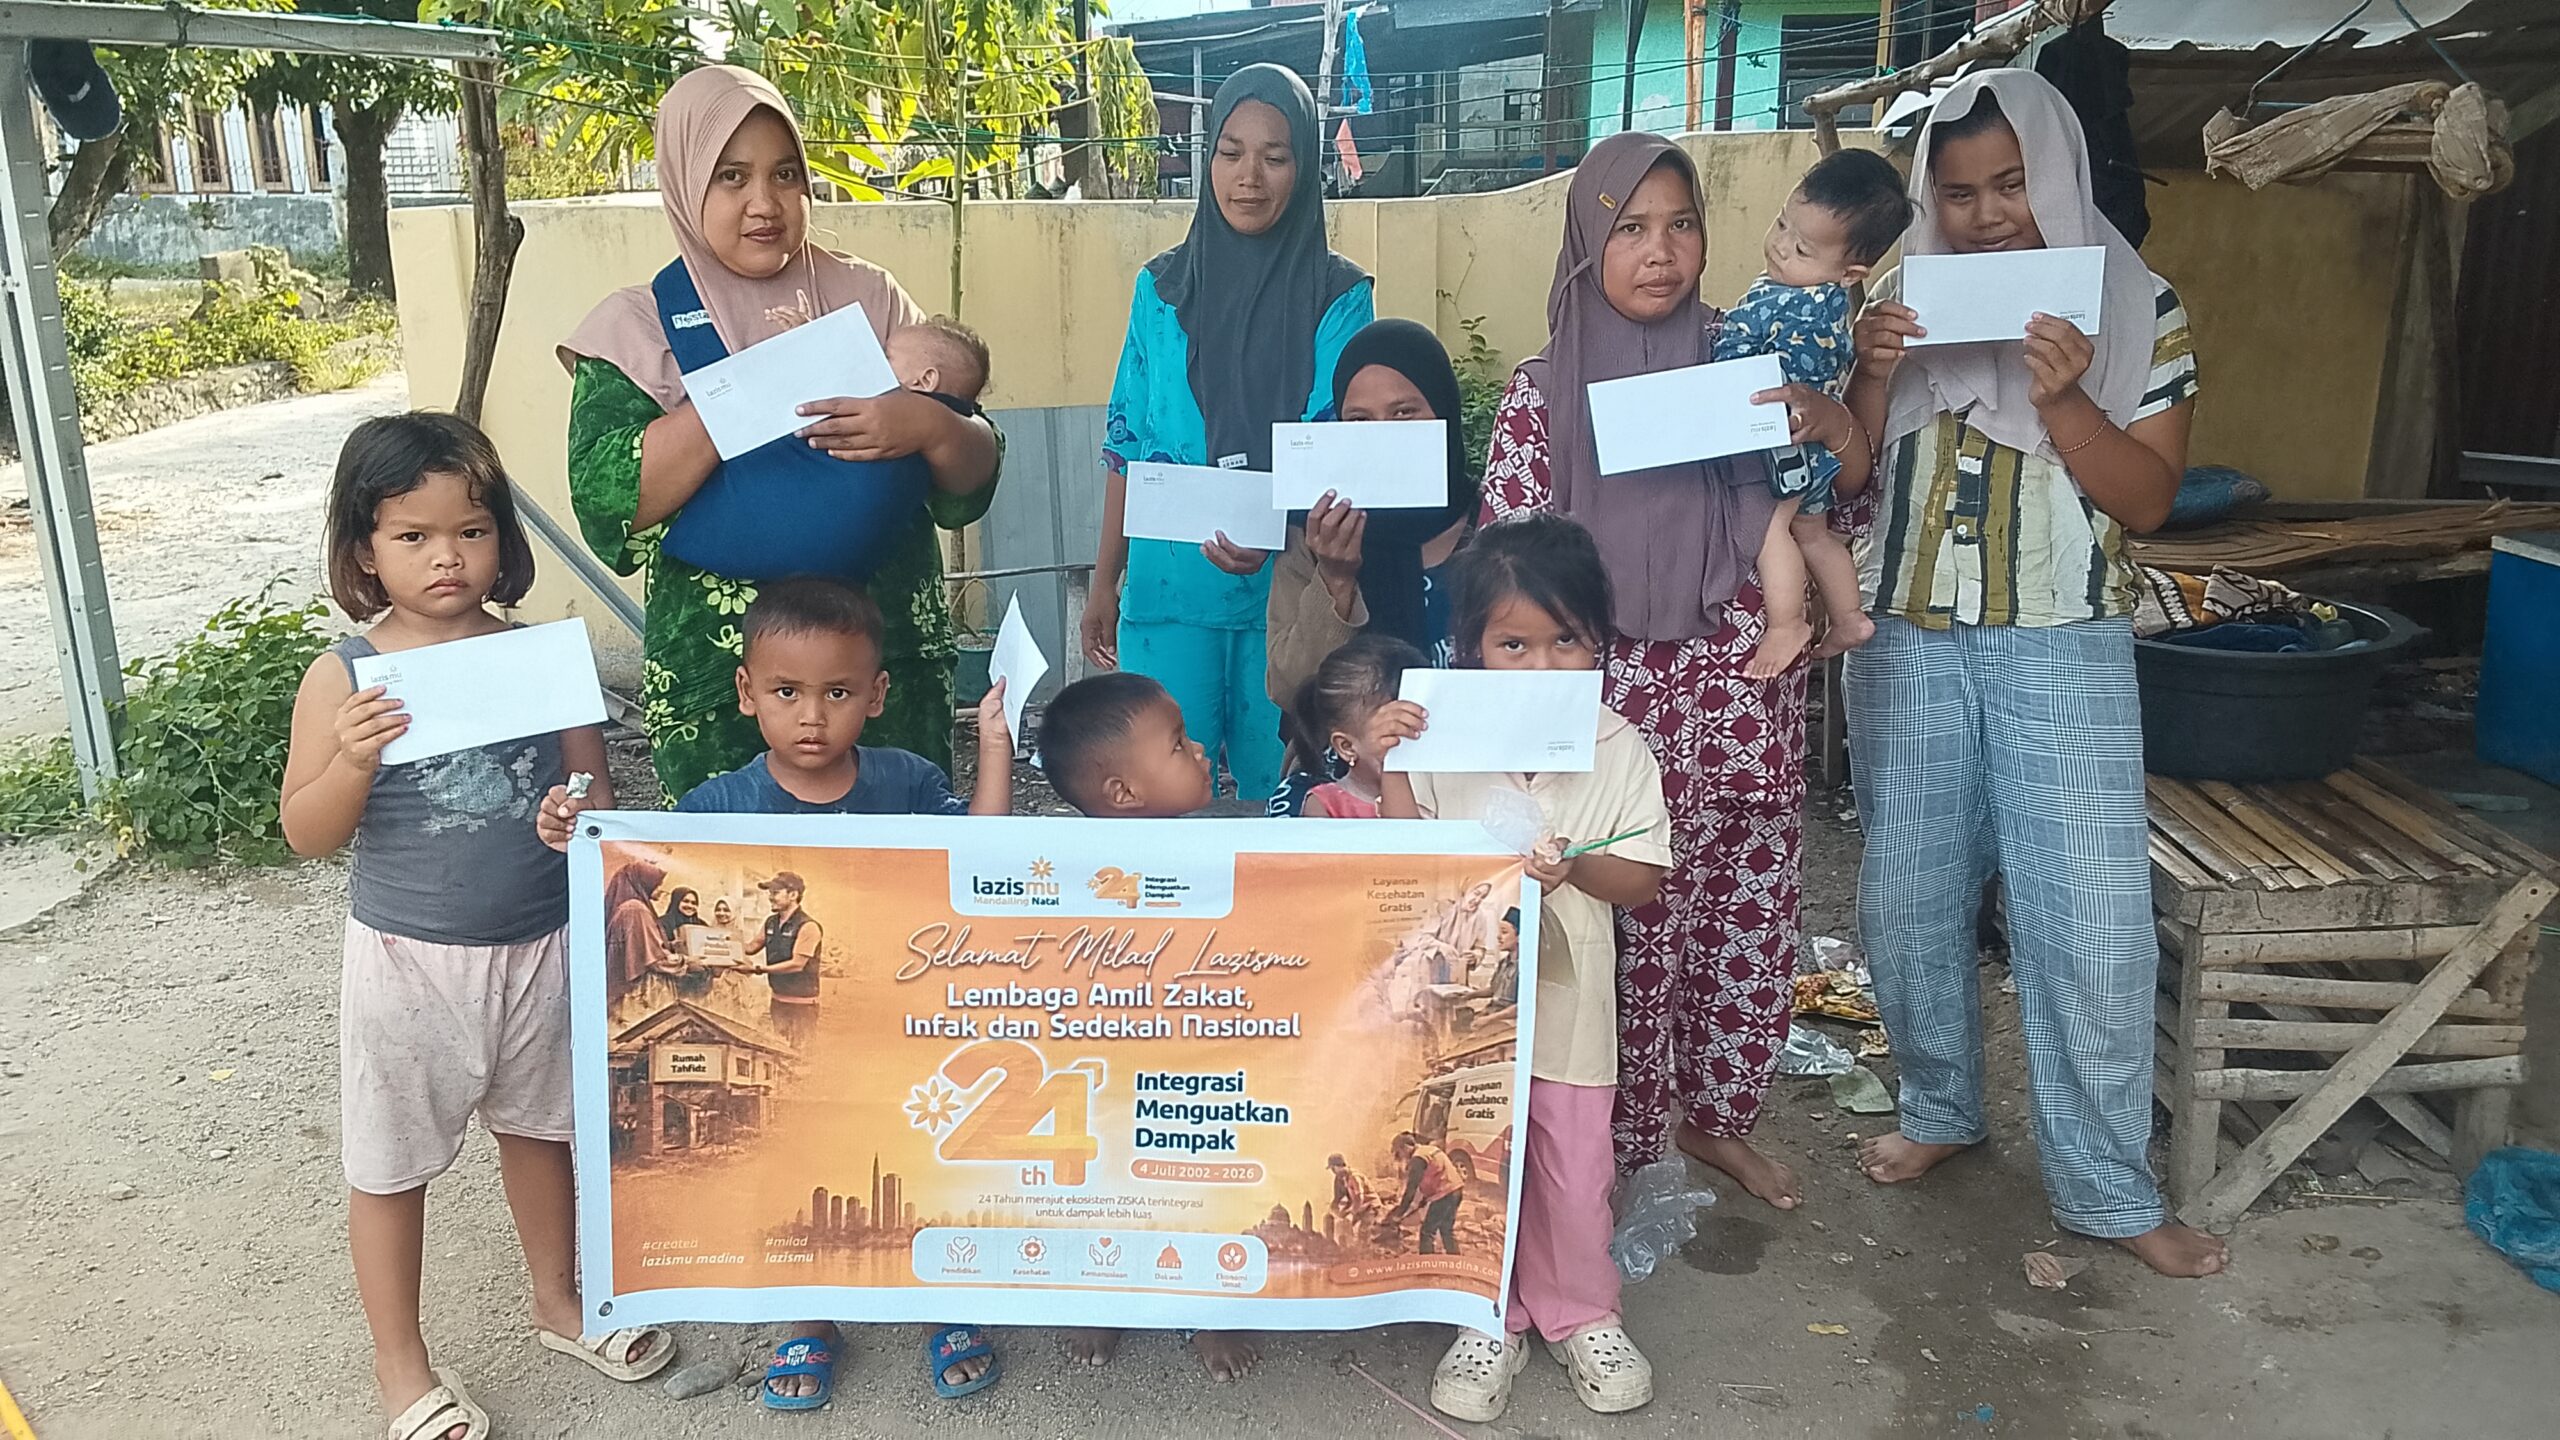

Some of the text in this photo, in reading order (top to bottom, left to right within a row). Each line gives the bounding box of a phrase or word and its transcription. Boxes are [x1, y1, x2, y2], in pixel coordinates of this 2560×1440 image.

[972, 876, 1059, 896] lazismu
[1373, 878, 1418, 887] Layanan
[1367, 890, 1425, 899] Kesehatan
[973, 896, 1059, 906] Mandailing Natal
[1379, 903, 1412, 912] Gratis
[896, 922, 1310, 980] Selamat Milad Lazismu
[947, 980, 1254, 1012] Lembaga Amil Zakat,
[905, 1013, 1301, 1038] Infak dan Sedekah Nasional
[672, 1054, 706, 1063] Rumah
[671, 1064, 707, 1073] Tahfidz
[1136, 1071, 1244, 1096] Integrasi
[1464, 1082, 1502, 1093] Layanan
[1456, 1094, 1509, 1106] Ambulance
[941, 1041, 1101, 1187] 24 th
[1135, 1099, 1289, 1125] Menguatkan
[1465, 1108, 1496, 1119] Gratis
[1135, 1128, 1236, 1154] Dampak
[1140, 1163, 1148, 1174] 4
[1151, 1165, 1175, 1176] Juli
[1179, 1167, 1210, 1178] 2002
[1222, 1168, 1255, 1178] 2026
[978, 1194, 1203, 1209] 24 Tahun merajut ekosistem ZISKA terintegrasi
[1035, 1208, 1152, 1219] untuk dampak lebih luas
[642, 1238, 698, 1250] #created
[765, 1235, 808, 1247] #milad
[642, 1253, 744, 1268] lazismu madina
[765, 1252, 814, 1264] lazismu
